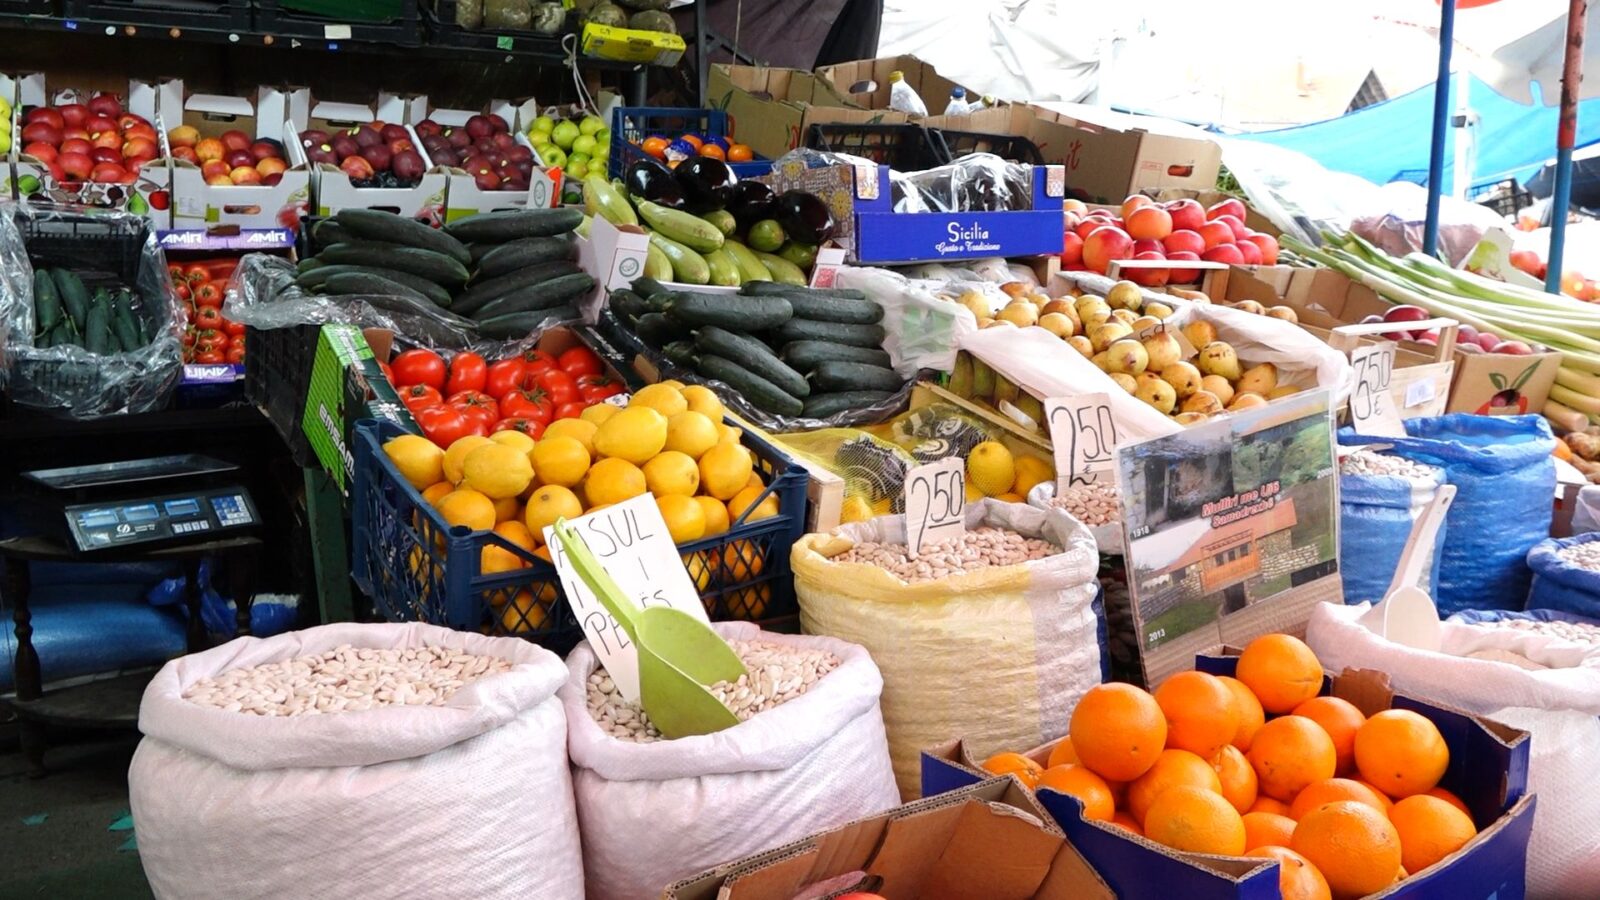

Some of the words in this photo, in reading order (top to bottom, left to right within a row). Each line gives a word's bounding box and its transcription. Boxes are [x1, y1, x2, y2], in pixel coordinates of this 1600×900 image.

[947, 221, 989, 243] Sicilia
[1050, 405, 1117, 487] 250
[1132, 525, 1150, 539] 1918
[1148, 628, 1166, 642] 2013
